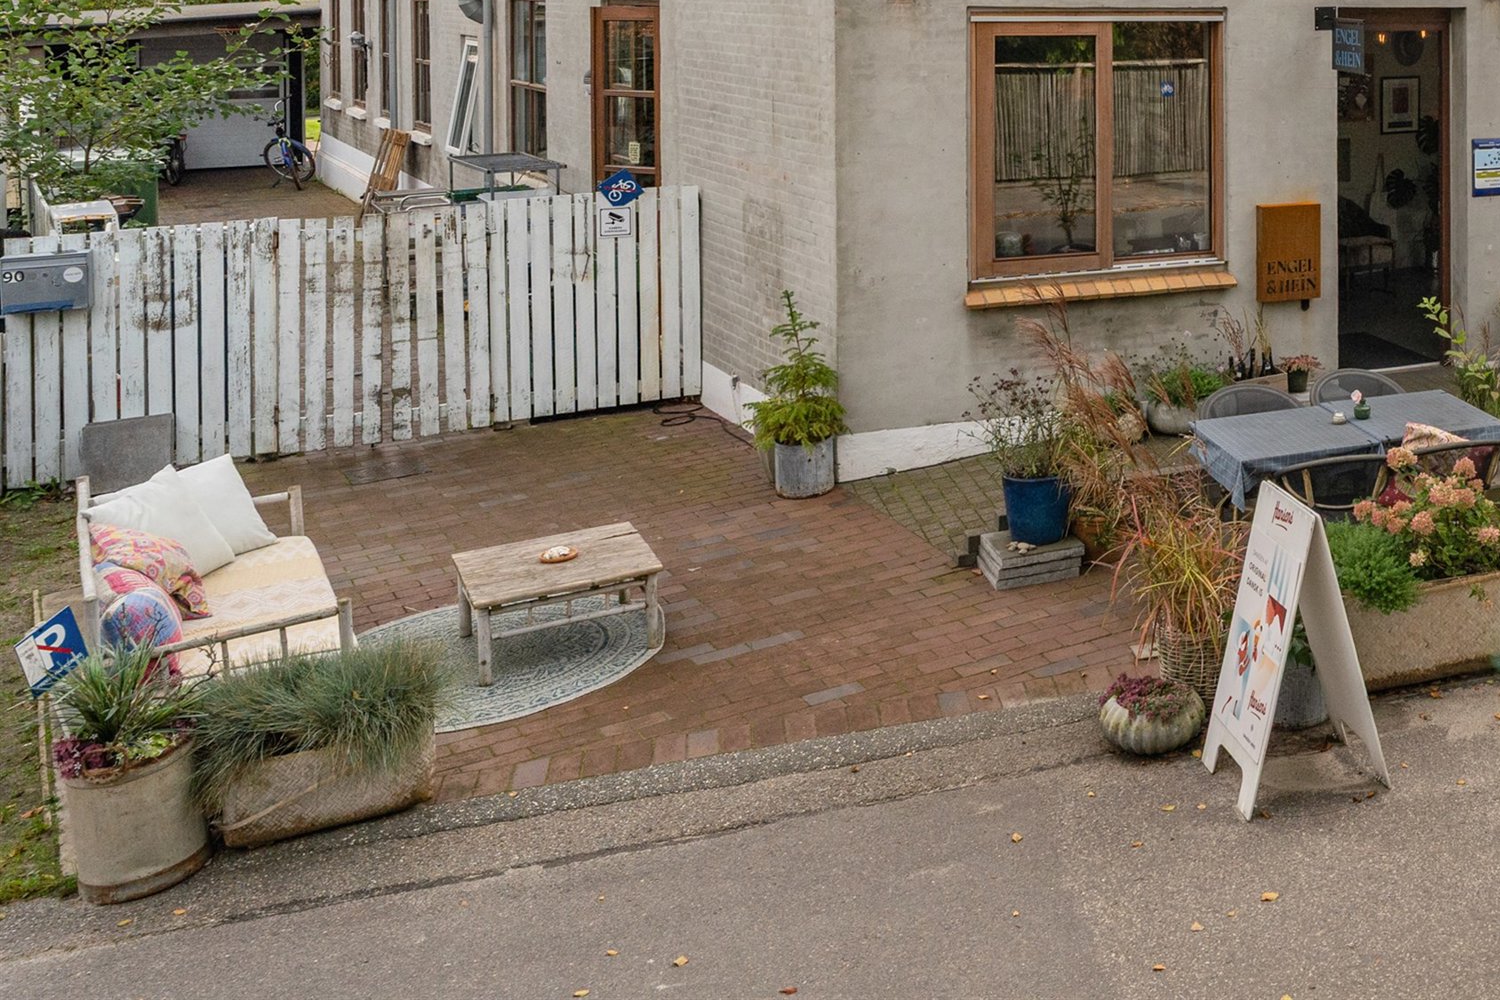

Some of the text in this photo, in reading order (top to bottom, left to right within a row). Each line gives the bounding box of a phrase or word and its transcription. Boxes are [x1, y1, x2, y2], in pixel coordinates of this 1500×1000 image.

[1335, 28, 1361, 46] ENGEL
[1266, 258, 1317, 275] ENGEL
[2, 270, 25, 283] 90
